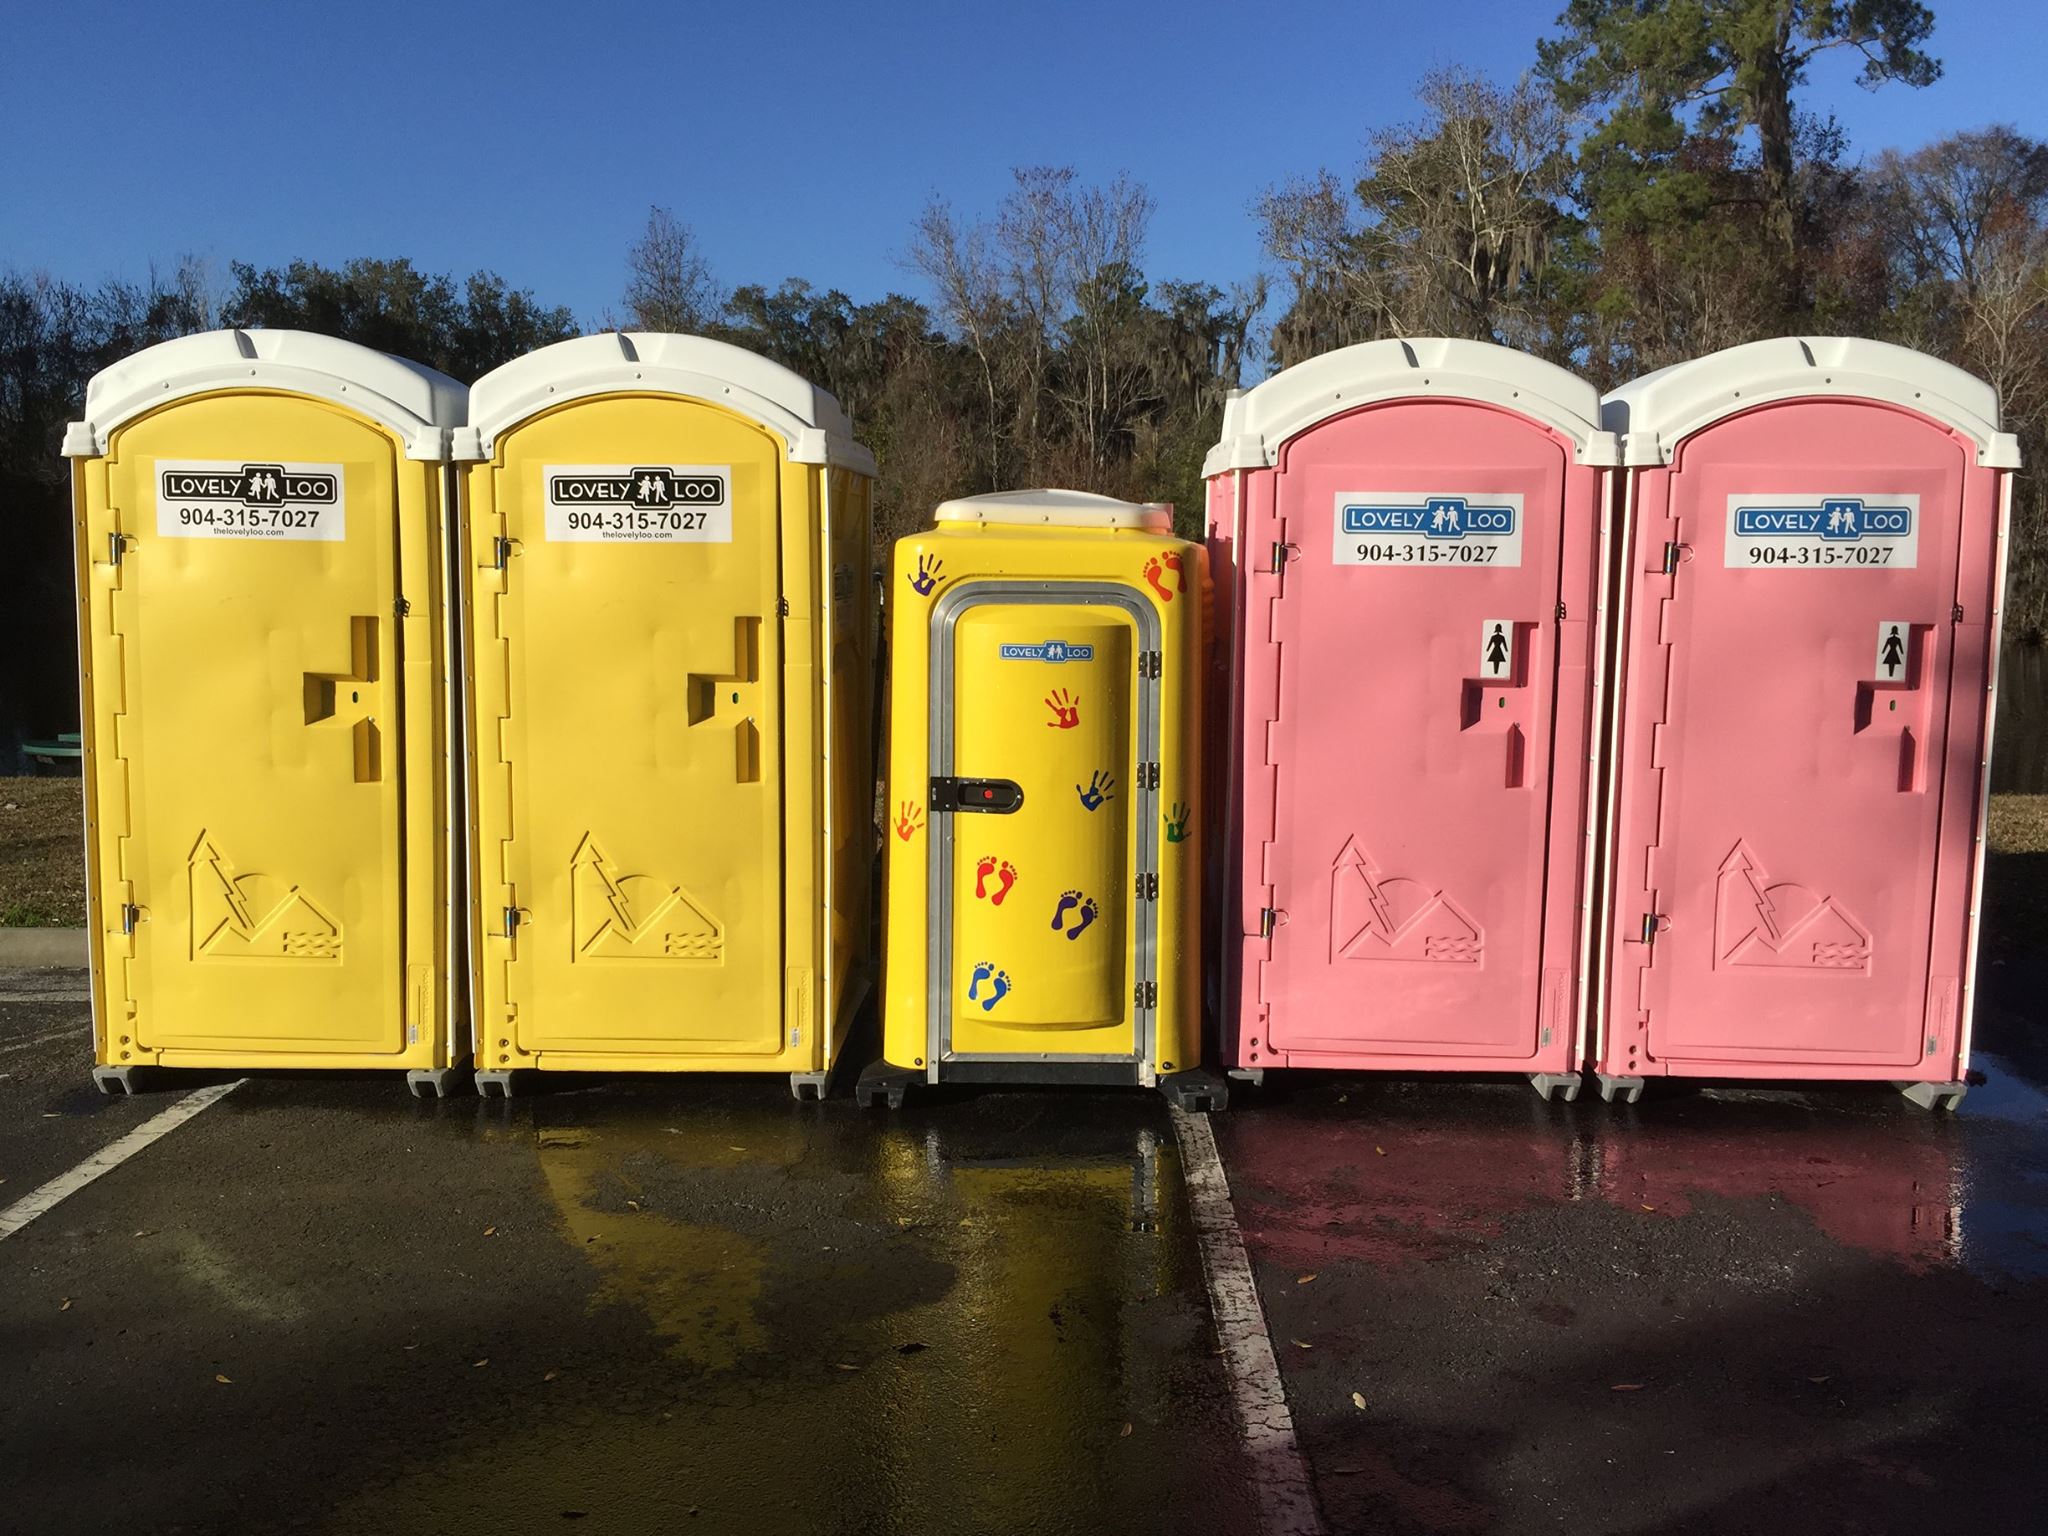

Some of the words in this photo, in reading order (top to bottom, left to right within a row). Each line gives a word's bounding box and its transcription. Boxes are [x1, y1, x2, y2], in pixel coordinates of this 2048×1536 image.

[170, 477, 241, 496] LOVELY
[286, 479, 328, 496] LOO
[559, 481, 631, 500] LOVELY
[674, 481, 716, 498] LOO
[180, 508, 320, 528] 904-315-7027
[568, 512, 708, 530] 904-315-7027
[1351, 510, 1425, 529] LOVELY
[1467, 512, 1507, 528] LOO
[1744, 513, 1821, 531] LOVELY
[1863, 513, 1903, 529] LOO
[213, 527, 284, 538] thelovelyloo.com
[602, 531, 673, 540] thelovelyloo.com
[1356, 544, 1498, 562] 904-315-7027
[1749, 547, 1894, 564] 904-315-7027
[1003, 647, 1044, 657] LOVELY
[1067, 648, 1089, 657] LOO
